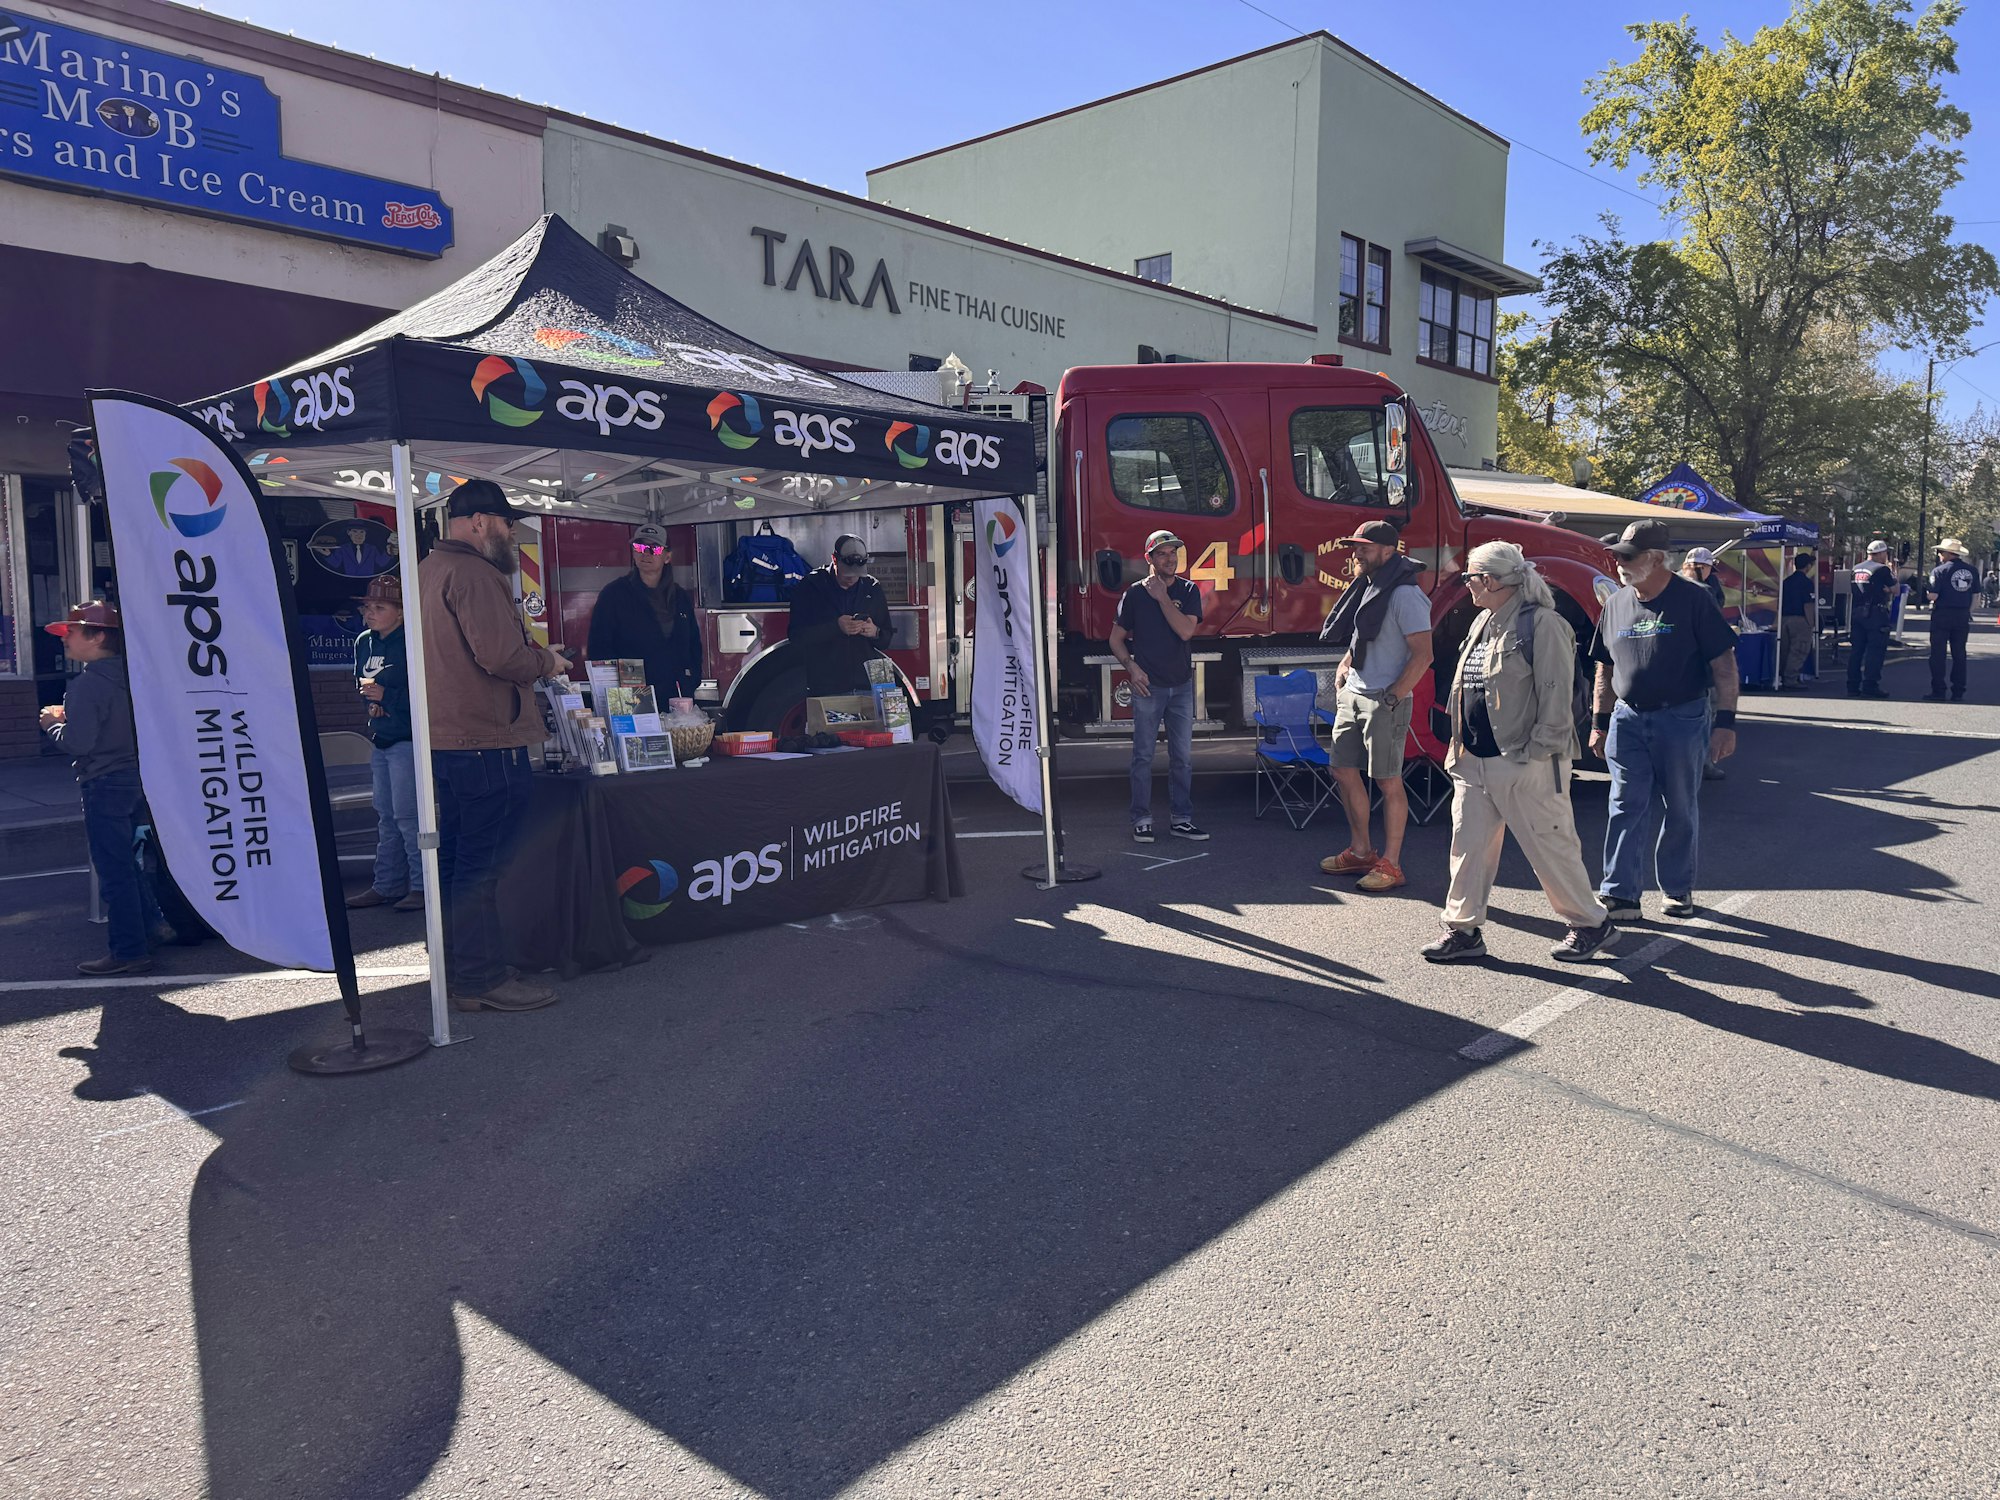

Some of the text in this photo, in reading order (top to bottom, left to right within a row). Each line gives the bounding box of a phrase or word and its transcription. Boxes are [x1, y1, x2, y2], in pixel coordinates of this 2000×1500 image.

[0, 31, 241, 118] Marino's
[54, 140, 142, 180] and
[157, 152, 223, 196] Ice
[239, 172, 366, 226] Cream
[751, 226, 1066, 339] TARA FINE THAI CUISINE
[311, 651, 348, 661] Burgers
[998, 655, 1017, 766] MITIGATION
[195, 709, 240, 901] MITIGATION
[231, 710, 272, 868] WILDFIRE
[803, 801, 903, 846] WILDFIRE
[804, 821, 921, 872] MITIGATION
